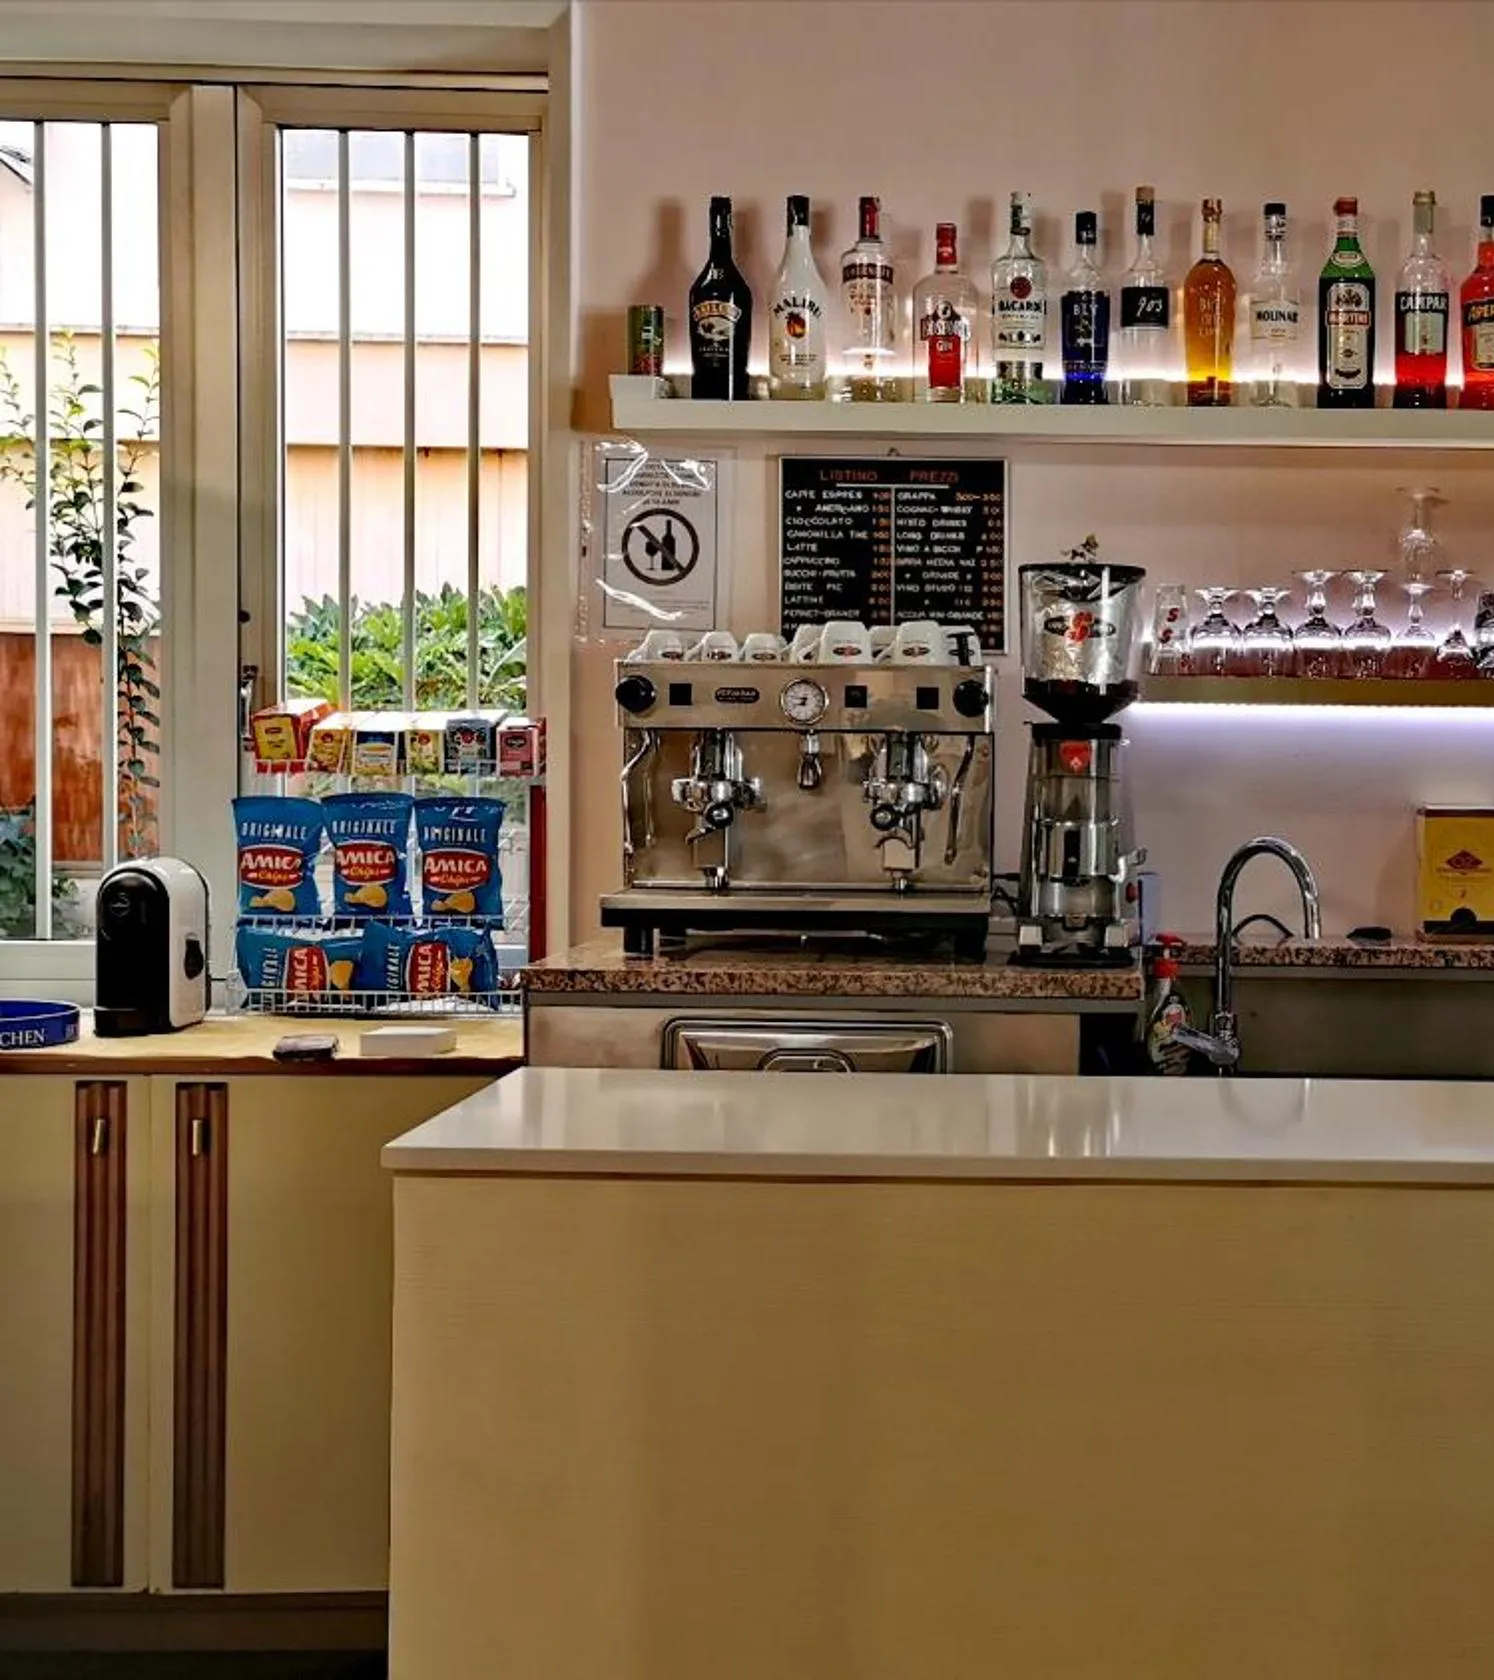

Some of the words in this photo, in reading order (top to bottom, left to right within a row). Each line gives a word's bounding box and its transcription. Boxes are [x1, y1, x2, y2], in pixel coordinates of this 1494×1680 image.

[819, 468, 879, 482] LISTINO
[240, 821, 308, 840] ORIGINALE
[331, 819, 397, 837] ORIGINALE
[240, 852, 302, 873] AMICA
[336, 848, 396, 867] AMICA
[424, 857, 488, 875] AMICA
